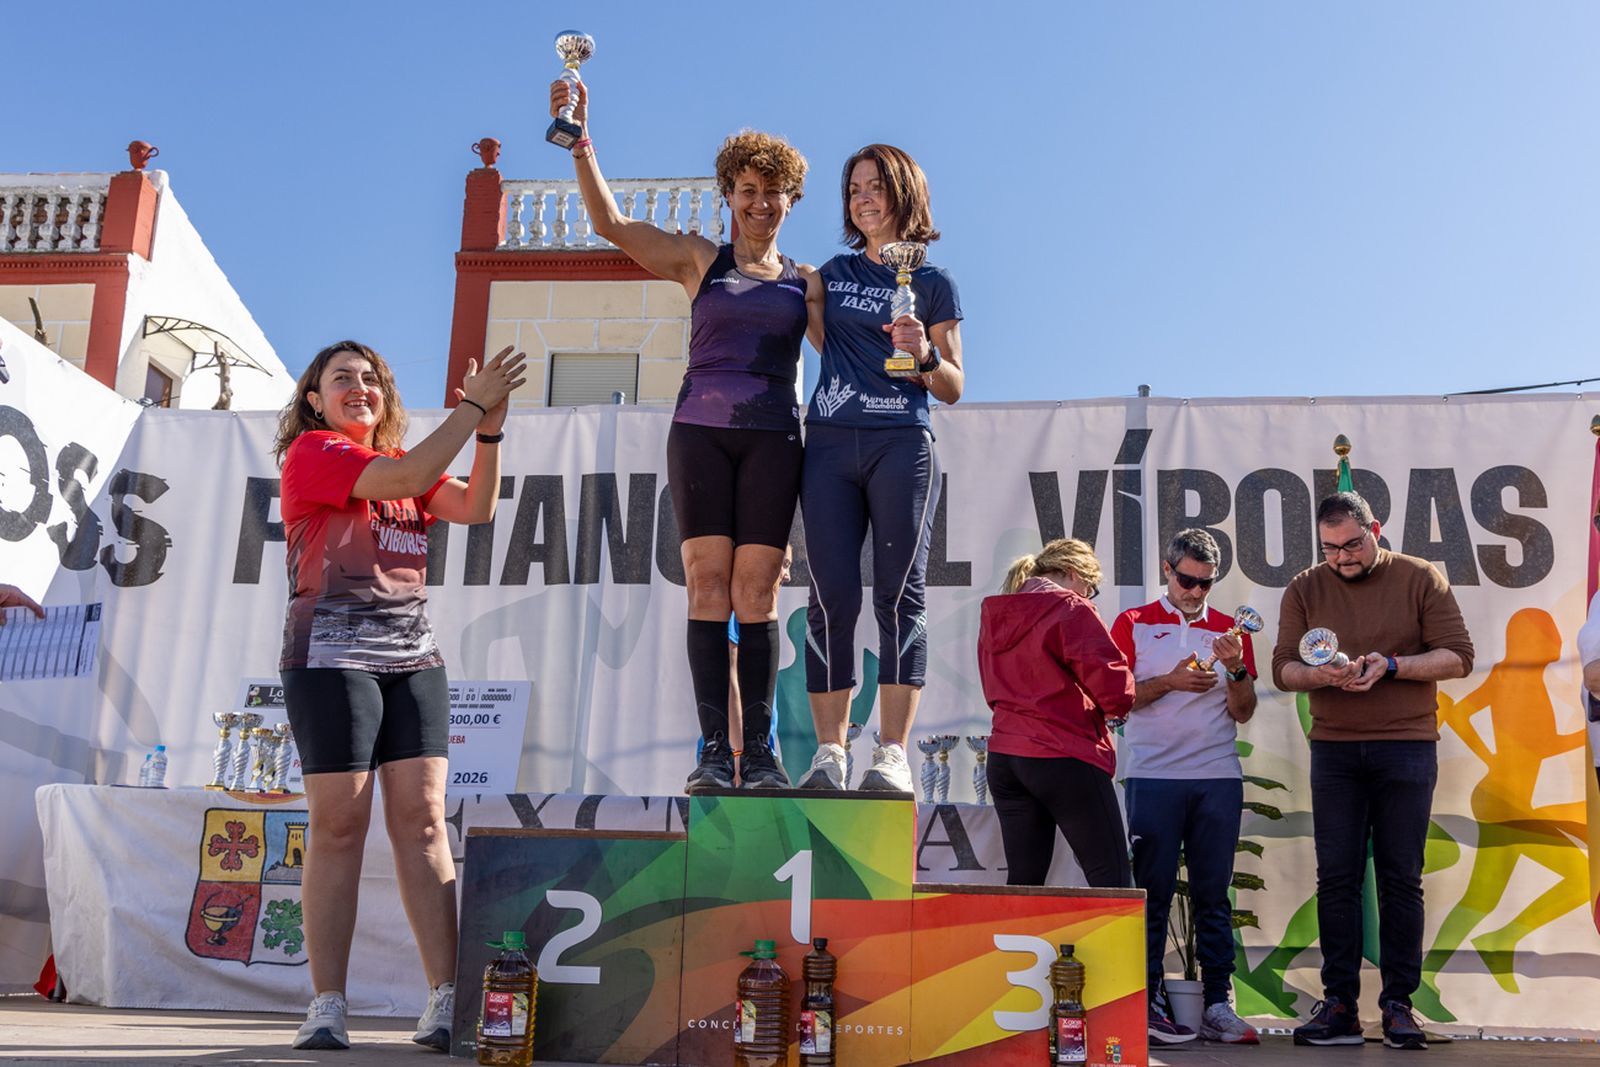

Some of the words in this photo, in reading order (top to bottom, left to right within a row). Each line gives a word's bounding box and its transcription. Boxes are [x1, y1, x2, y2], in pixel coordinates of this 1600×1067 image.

[861, 286, 896, 302] RUR
[840, 295, 884, 314] JAÉN
[453, 772, 488, 784] 2026
[773, 850, 812, 944] 1
[537, 889, 602, 984] 2
[993, 934, 1058, 1031] 3
[835, 1023, 904, 1036] EPORTES
